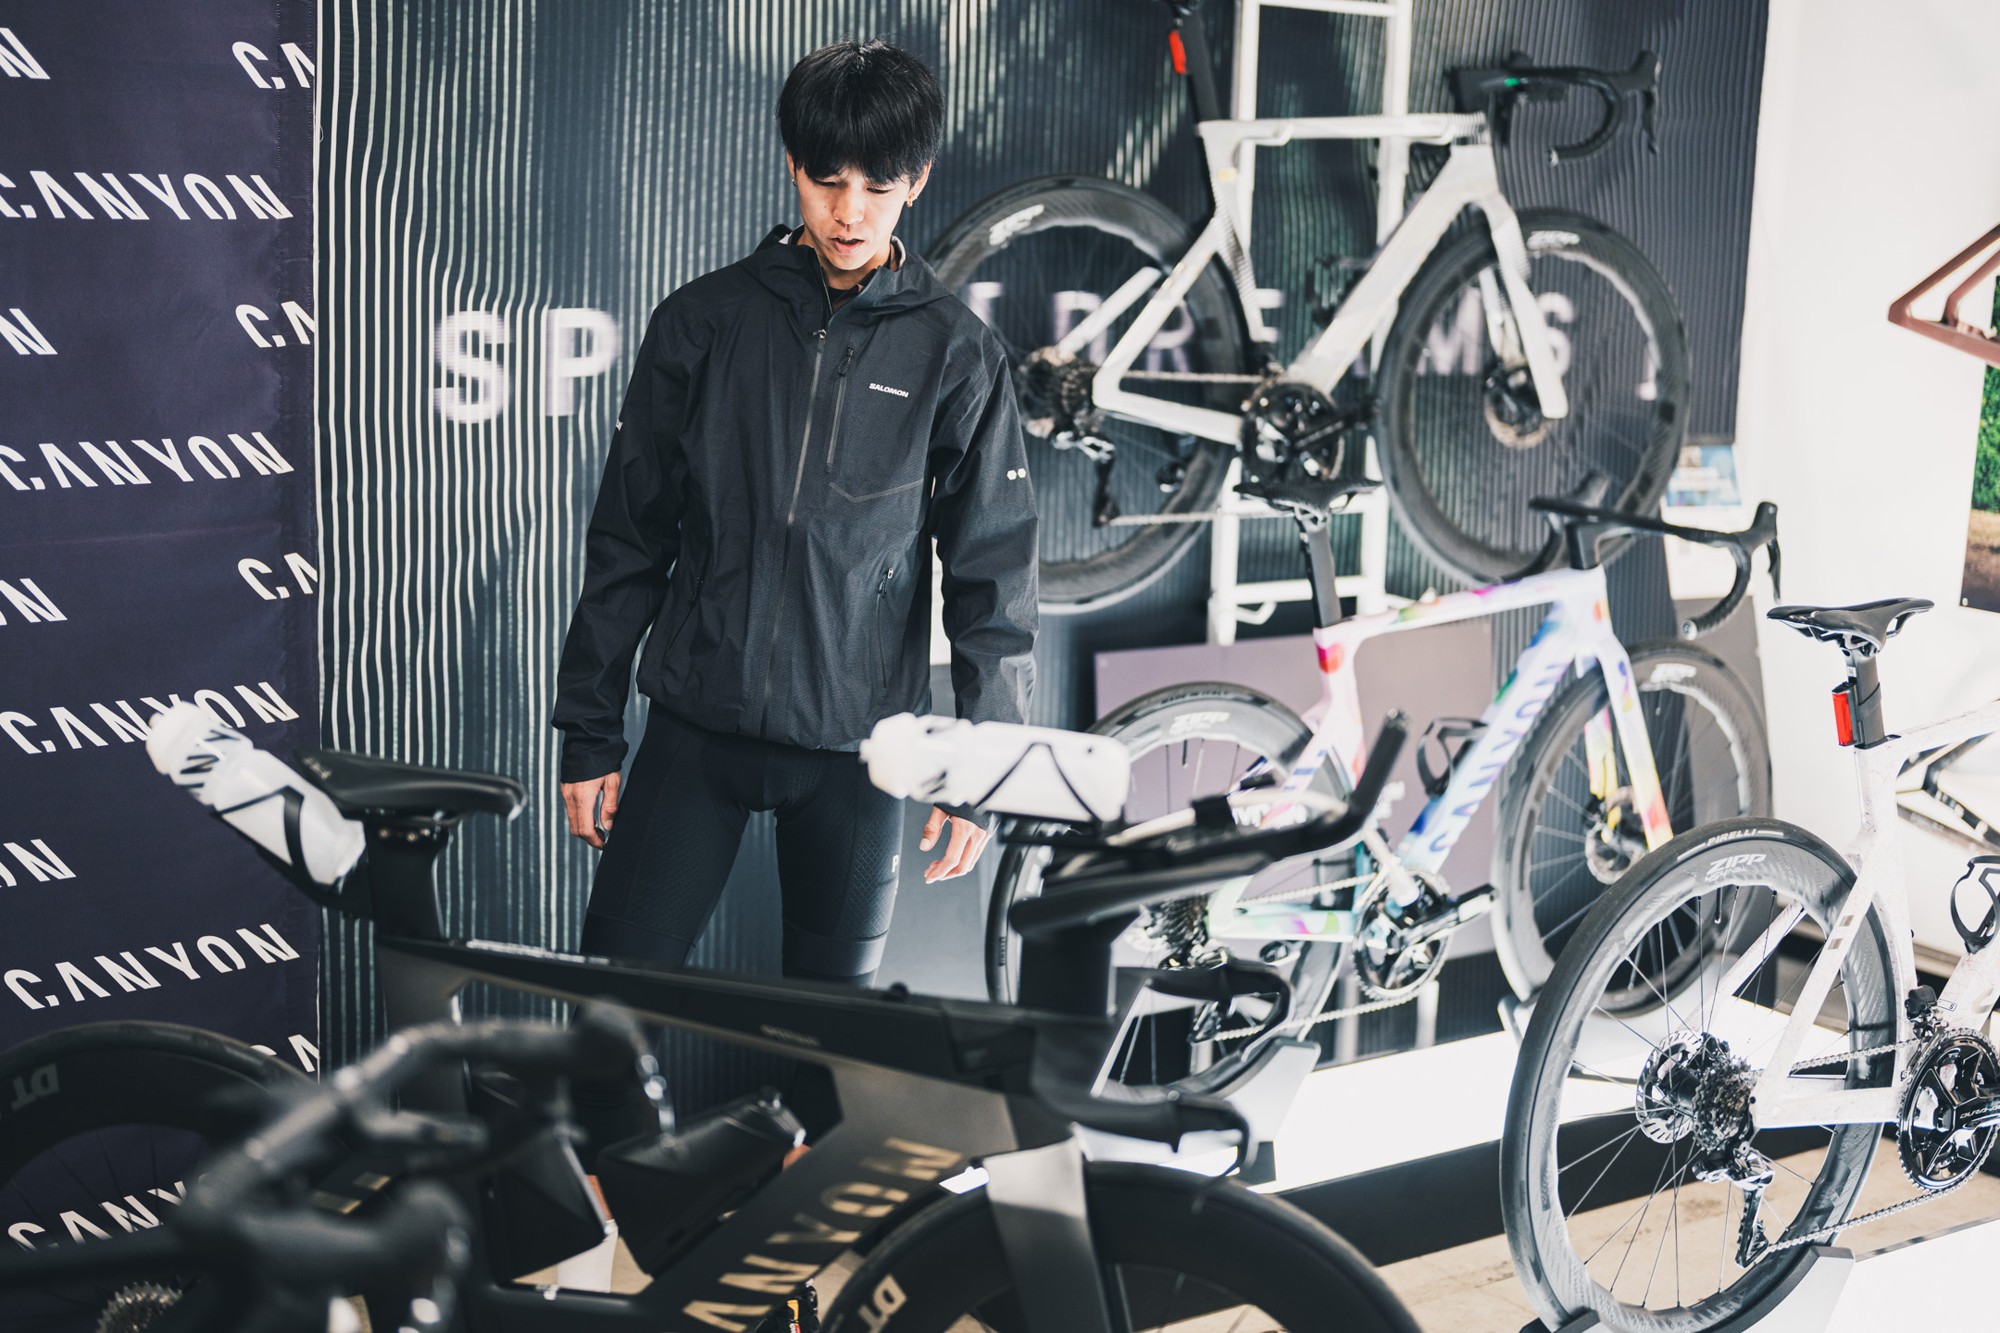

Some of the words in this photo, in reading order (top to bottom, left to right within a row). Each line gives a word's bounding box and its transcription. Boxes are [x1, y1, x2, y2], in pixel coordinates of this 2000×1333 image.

[868, 382, 910, 398] SALOMON
[0, 431, 295, 491] CANYON
[1706, 828, 1757, 847] PIRELLI
[1706, 853, 1767, 877] ZIPP
[3, 923, 301, 1011] CANYON
